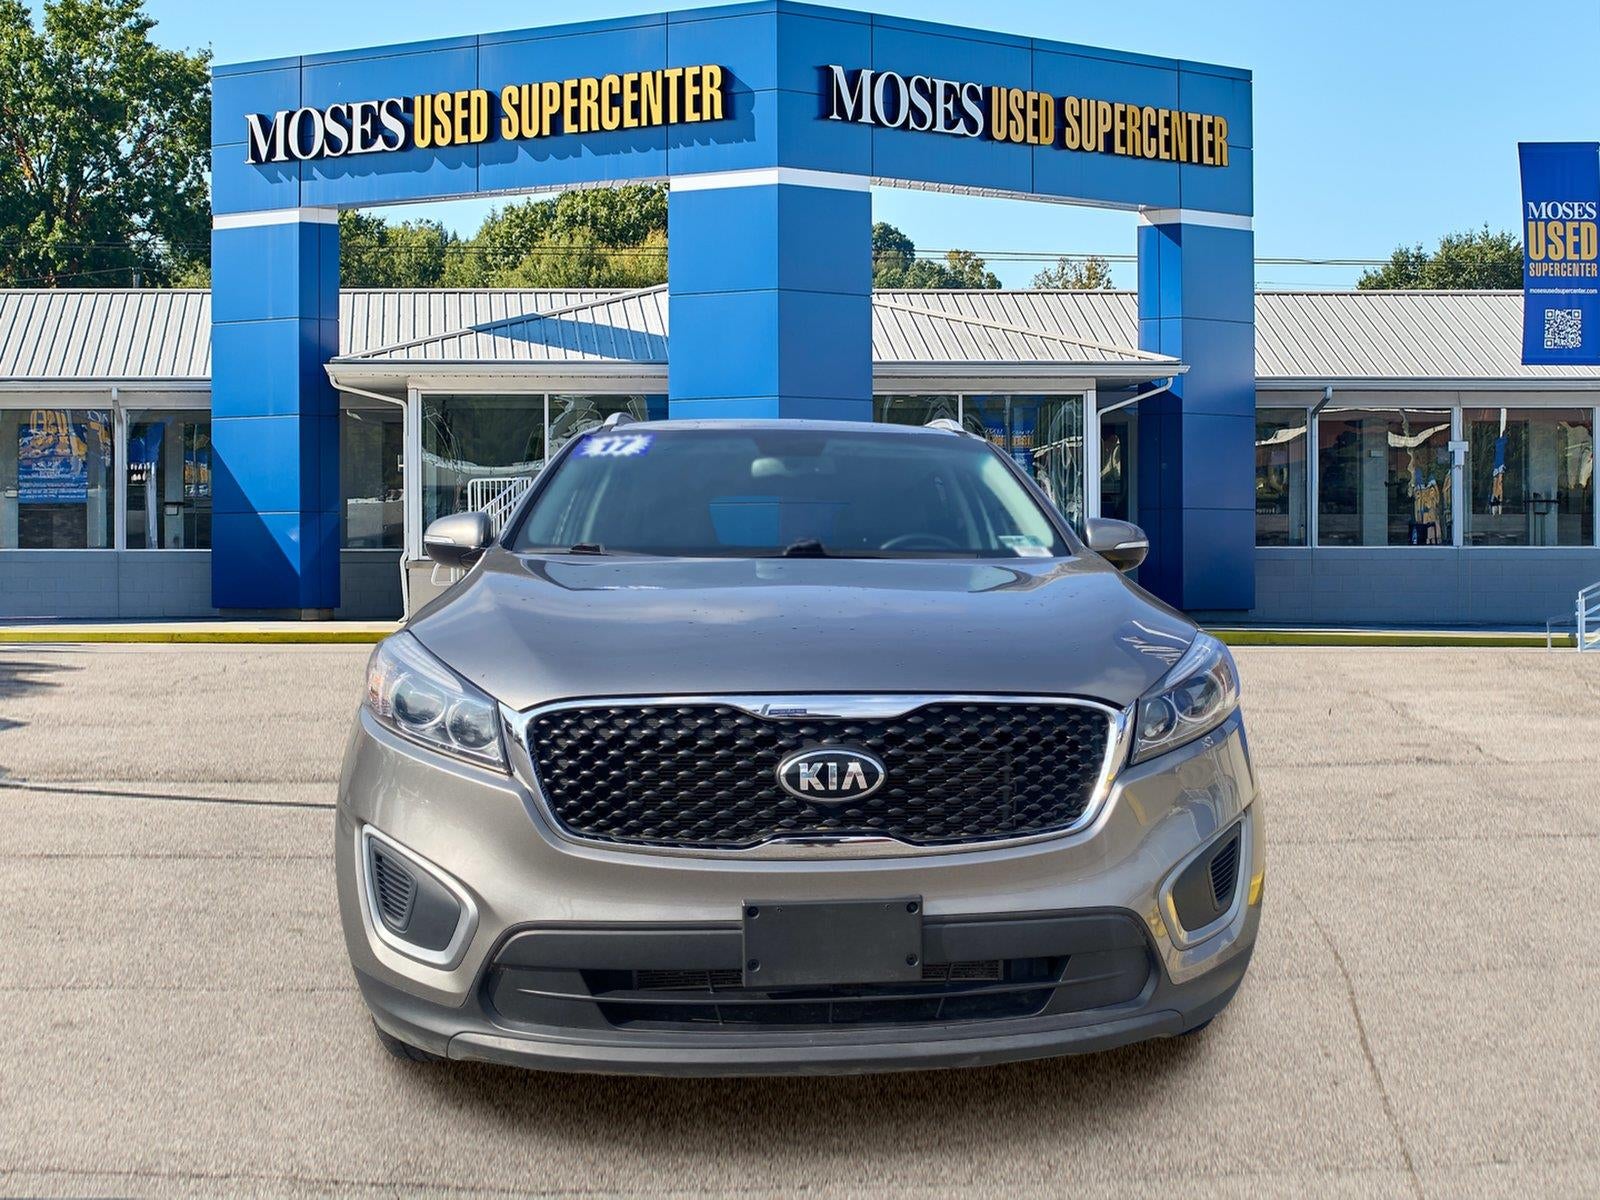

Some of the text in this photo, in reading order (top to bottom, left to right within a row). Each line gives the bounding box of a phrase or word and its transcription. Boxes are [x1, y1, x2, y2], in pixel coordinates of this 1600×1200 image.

[245, 64, 724, 165] MOSES USED SUPERCENTER
[828, 64, 1230, 167] MOSES USED SUPERCENTER
[1527, 201, 1597, 220] MOSES
[1528, 221, 1598, 261] USED
[1529, 262, 1598, 278] SUPERCENTER
[798, 761, 869, 791] KIA
